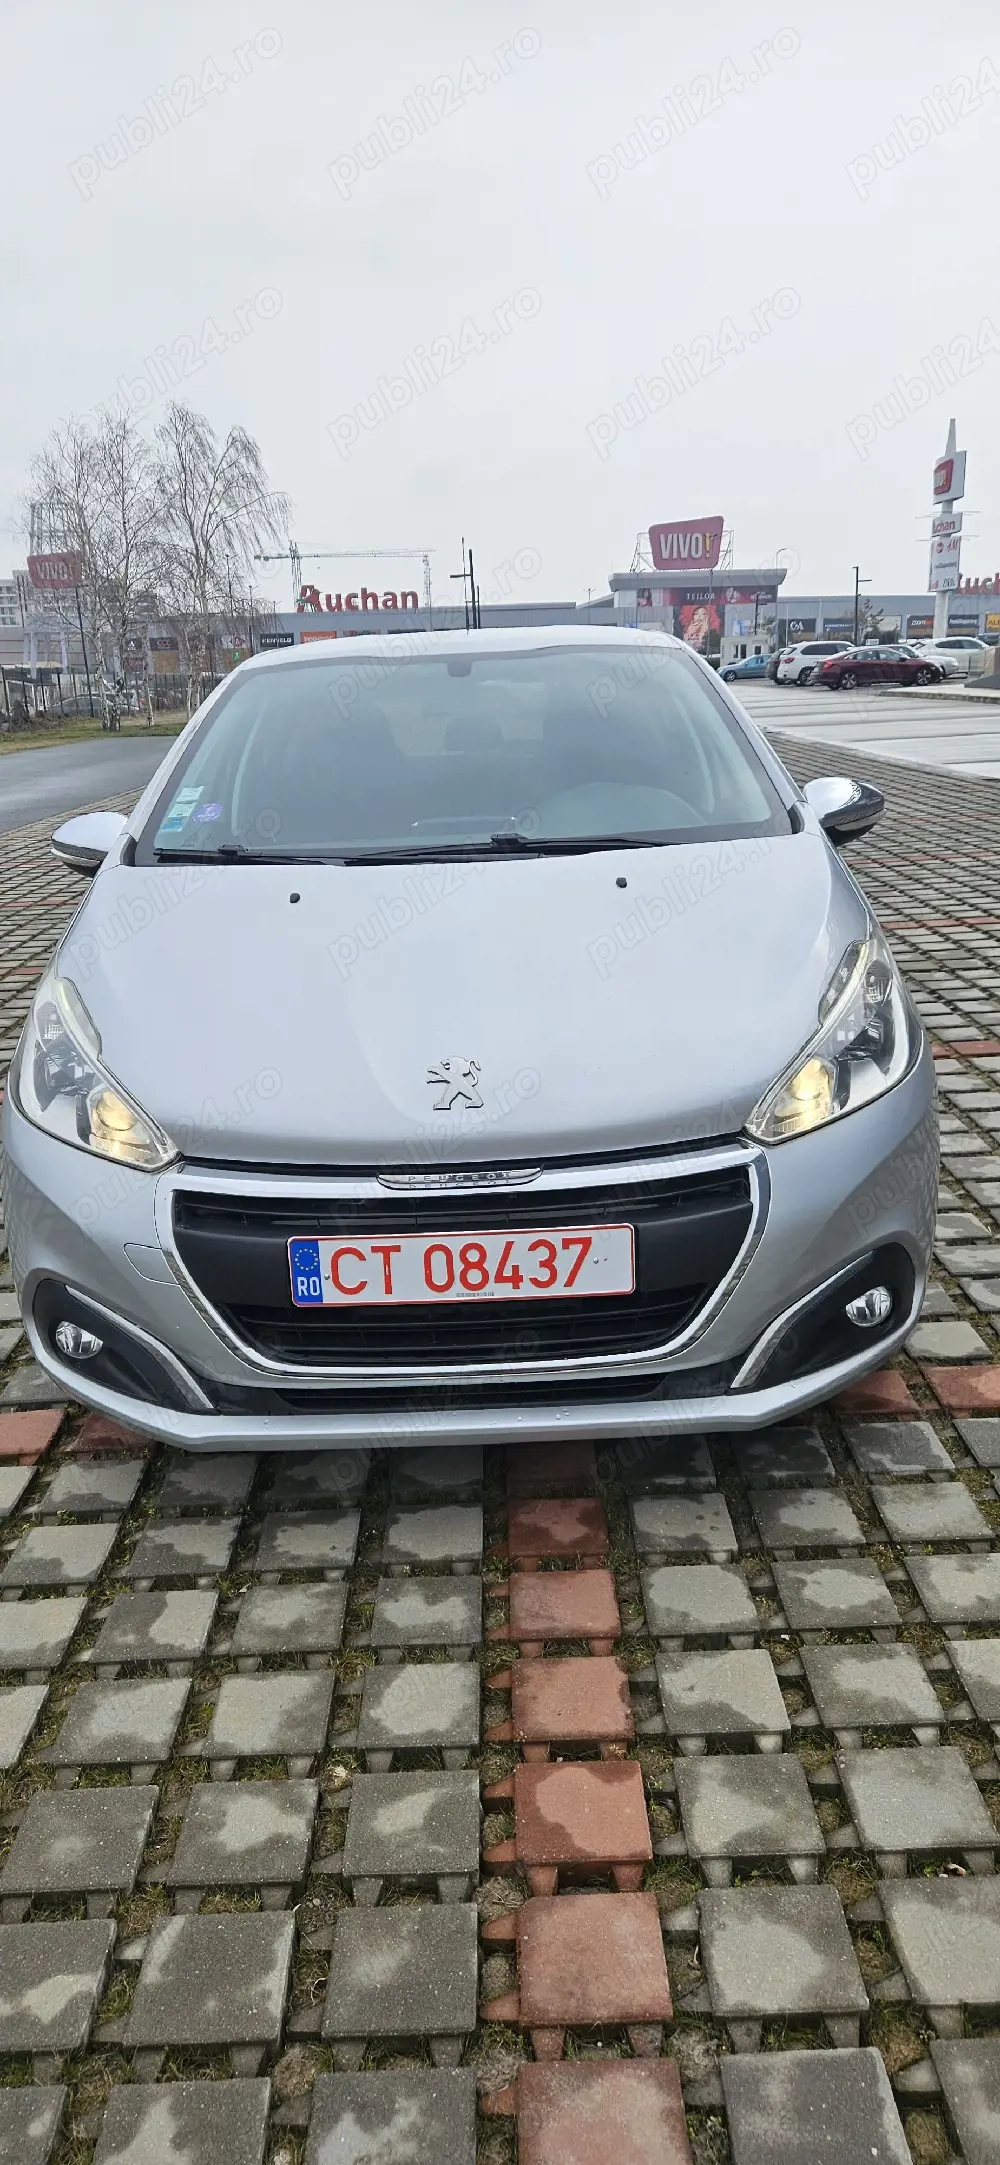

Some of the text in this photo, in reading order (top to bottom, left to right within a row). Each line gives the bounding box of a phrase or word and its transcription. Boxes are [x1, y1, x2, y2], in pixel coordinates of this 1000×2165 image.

[660, 532, 711, 559] VIVO!
[298, 585, 419, 613] Auchan
[408, 1171, 511, 1182] PEUGEOT
[330, 1236, 592, 1296] CT 08437
[297, 1276, 320, 1297] RO
